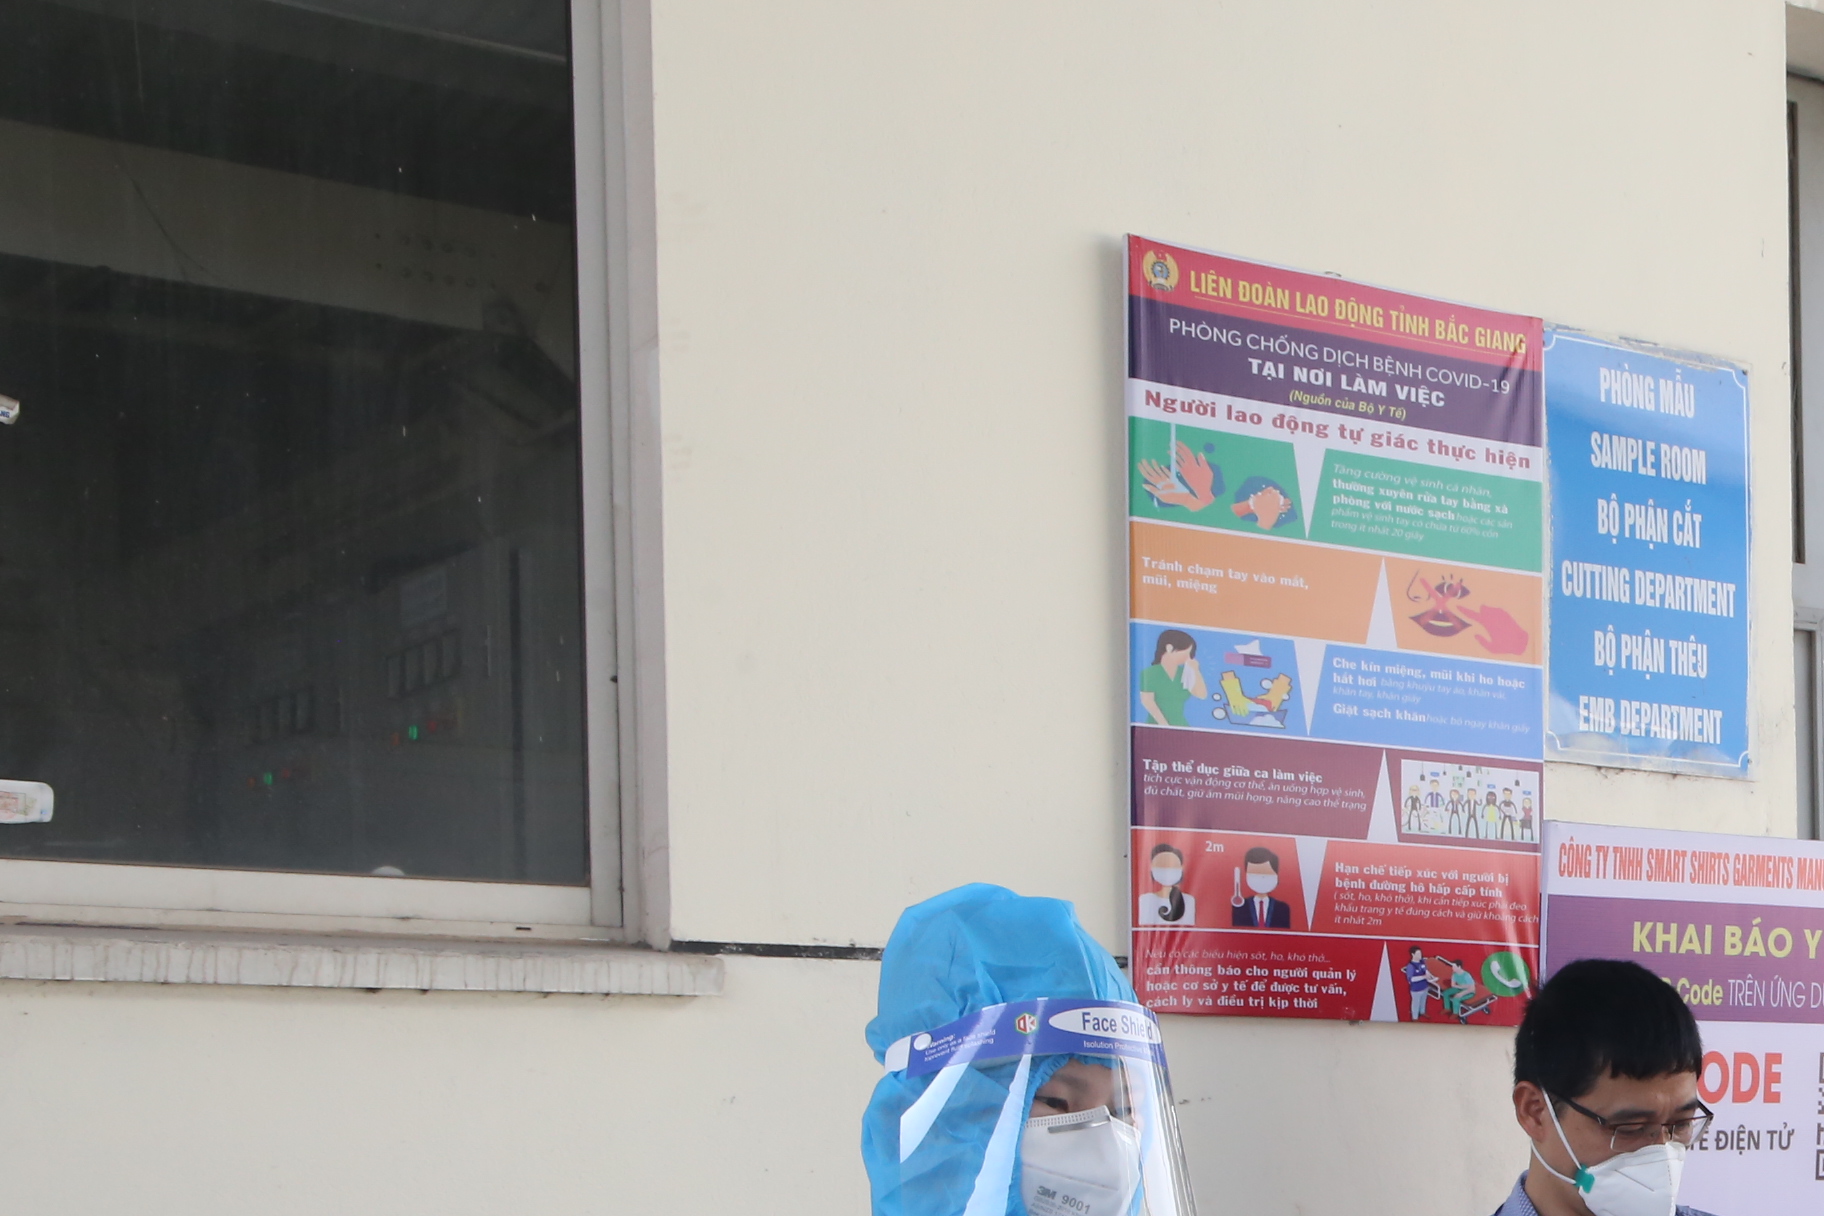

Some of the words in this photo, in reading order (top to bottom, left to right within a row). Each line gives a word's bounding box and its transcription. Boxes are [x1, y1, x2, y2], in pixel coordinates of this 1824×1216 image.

[1190, 269, 1232, 299] LIÊN
[1238, 281, 1289, 310] ĐOÀN
[1296, 291, 1328, 317] LAO
[1335, 297, 1384, 328] ĐỘNG
[1389, 305, 1429, 337] TỈNH
[1435, 315, 1469, 344] BẮC
[1475, 327, 1527, 353] GIANG
[1169, 317, 1242, 347] PHÒNG
[1247, 334, 1319, 360] CHỐNG
[1324, 347, 1369, 370] DỊCH
[1373, 356, 1422, 379] BỆNH
[1426, 366, 1510, 394] COVID-19
[1248, 358, 1285, 381] TẠI
[1293, 366, 1332, 387] NƠI
[1341, 373, 1387, 397] LÀM
[1395, 385, 1445, 407] VIỆC
[1600, 363, 1655, 411] PHÒNG
[1659, 368, 1695, 418] MẪU
[1145, 390, 1217, 418] Người
[1227, 405, 1263, 425] lao
[1272, 413, 1329, 439] động
[1338, 423, 1364, 445] tự
[1370, 432, 1419, 450] giác
[1427, 439, 1476, 462] thực
[1485, 448, 1530, 470] hiện
[1590, 431, 1656, 477] SAMPLE
[1660, 443, 1707, 485] ROOM
[1597, 492, 1619, 544] BỘ
[1624, 498, 1668, 550] PHẬN
[1673, 499, 1702, 549] CẮT
[1142, 556, 1182, 572] Tránh
[1187, 562, 1224, 578] chạm
[1228, 568, 1248, 582] tay
[1253, 572, 1275, 585] vào
[1280, 575, 1309, 590] mắt,
[1142, 574, 1172, 588] mũi,
[1176, 577, 1218, 594] miệng
[1561, 559, 1630, 604] CUTTING
[1634, 569, 1736, 618] DEPARTMENT
[1594, 624, 1616, 676] BỘ
[1621, 629, 1665, 680] PHẬN
[1669, 635, 1707, 679] THÊU
[1333, 702, 1359, 716] Giặt
[1362, 707, 1391, 720] sạch
[1395, 709, 1426, 722] khăn
[1579, 694, 1615, 734] EMB
[1620, 699, 1722, 744] DEPARTMENT
[1142, 758, 1168, 773] Tập
[1171, 759, 1195, 773] thể
[1196, 763, 1219, 777] dục
[1223, 765, 1250, 778] giữa
[1254, 768, 1269, 779] ca
[1272, 768, 1295, 781] làm
[1298, 771, 1323, 784] việc
[1205, 841, 1225, 853] 2m
[1559, 836, 1592, 879] CÔNG
[1596, 845, 1610, 879] TY
[1613, 846, 1644, 881] TNHH
[1646, 848, 1687, 883] SMART
[1689, 850, 1730, 886] SHIRTS
[1733, 853, 1794, 889] GARMENTS
[1335, 861, 1359, 875] Hạn
[1363, 864, 1388, 876] chế
[1389, 865, 1412, 878] tiếp
[1416, 867, 1438, 879] xúc
[1441, 869, 1459, 880] với
[1462, 871, 1495, 884] người
[1497, 872, 1509, 886] bị
[1633, 921, 1712, 955] KHAI
[1724, 917, 1793, 958] BÁO
[1804, 929, 1823, 959] Y
[1146, 964, 1170, 975] cần
[1175, 964, 1212, 977] thông
[1217, 964, 1242, 976] báo
[1245, 965, 1269, 977] cho
[1273, 966, 1308, 979] người
[1312, 967, 1342, 980] quản
[1346, 969, 1357, 982] lý
[1146, 980, 1178, 994] hoặc
[1183, 981, 1198, 991] cơ
[1202, 978, 1219, 991] sở
[1222, 983, 1229, 993] y
[1233, 979, 1249, 992] tế
[1250, 978, 1268, 992] để
[1270, 981, 1300, 996] được
[1304, 983, 1319, 993] tư
[1321, 983, 1347, 996] vấn,
[1727, 973, 1766, 1007] TRÊN
[1770, 975, 1806, 1009] ỨNG
[1146, 996, 1177, 1008] cách
[1182, 995, 1193, 1008] ly
[1197, 996, 1213, 1007] và
[1217, 994, 1244, 1007] điều
[1248, 996, 1265, 1010] trị
[1269, 996, 1289, 1010] kịp
[1293, 997, 1318, 1009] thời
[1082, 1012, 1117, 1033] Face
[1697, 1050, 1782, 1104] ODE
[1715, 1124, 1760, 1155] ĐIỆN
[1767, 1122, 1795, 1151] TỬ
[1037, 1186, 1057, 1200] 3M
[1061, 1195, 1090, 1214] 9001
